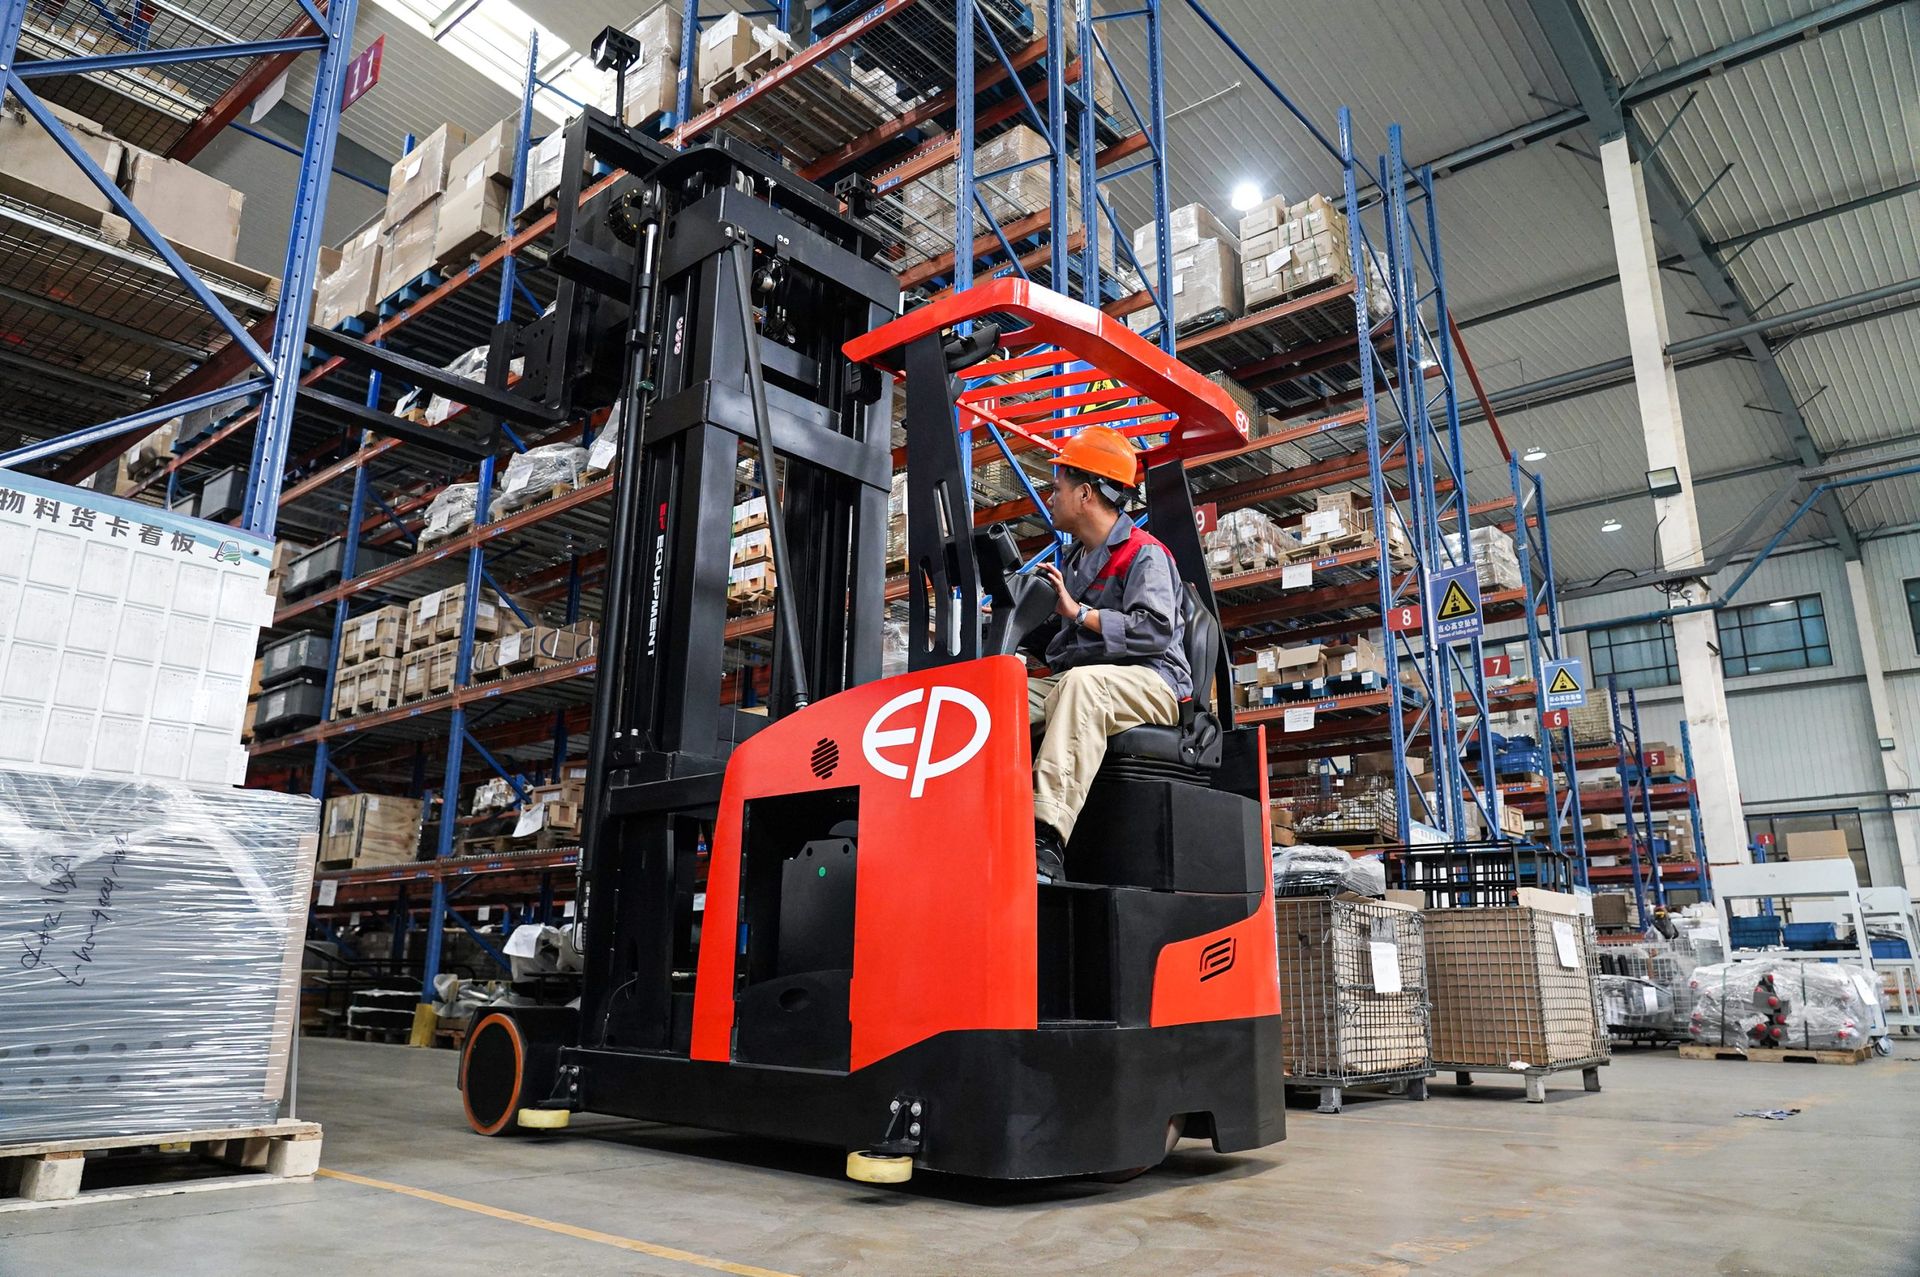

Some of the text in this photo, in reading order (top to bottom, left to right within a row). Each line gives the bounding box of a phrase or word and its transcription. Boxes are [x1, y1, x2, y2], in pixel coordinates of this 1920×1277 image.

[350, 49, 375, 99] 11
[0, 488, 196, 555] 物料货卡看板
[1195, 510, 1205, 532] 9
[647, 502, 668, 657] EP EQUIPMENT
[1402, 609, 1412, 626] 8
[1492, 659, 1501, 674] 7
[1553, 712, 1562, 726] 6
[862, 686, 992, 799] EP
[1650, 752, 1659, 765] 5
[1764, 835, 1770, 844] 1
